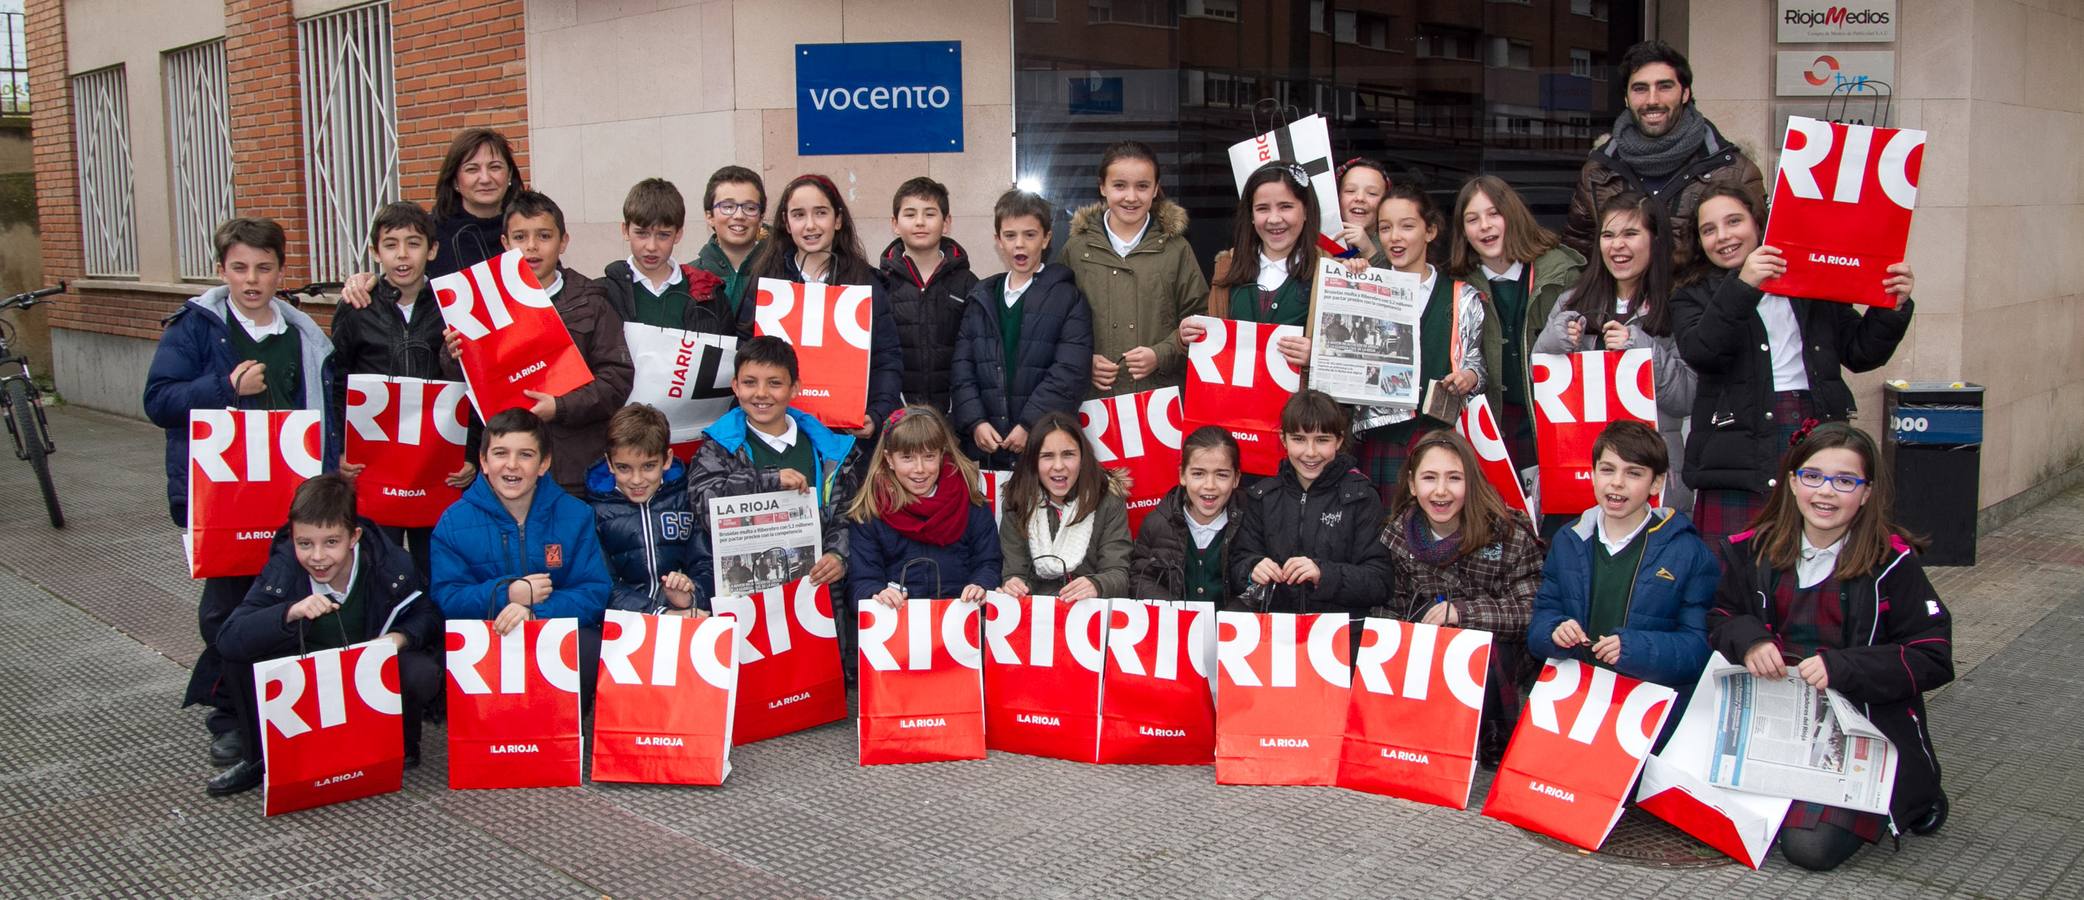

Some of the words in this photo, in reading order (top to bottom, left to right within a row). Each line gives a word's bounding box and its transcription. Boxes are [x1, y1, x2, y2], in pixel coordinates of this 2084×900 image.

[1785, 6, 1889, 28] RiojaMedios
[1835, 72, 1868, 92] tvr
[809, 85, 950, 112] vocento
[1811, 252, 1826, 264] LA
[1827, 254, 1861, 267] RIOJA
[1325, 265, 1341, 276] LA
[1344, 271, 1383, 283] RIOJA
[510, 370, 523, 383] LA
[522, 360, 547, 376] RIOJA
[802, 389, 830, 398] RIOJA
[1577, 472, 1590, 480] LA
[384, 487, 398, 497] LA
[398, 488, 427, 498] RIOJA
[717, 504, 735, 516] LA
[740, 500, 779, 514] RIOJA
[1126, 500, 1139, 510] LA
[661, 512, 694, 540] 65
[238, 531, 253, 541] LA
[252, 530, 277, 540] RIOJ
[769, 698, 784, 710] LA
[783, 691, 811, 705] RIOJA
[902, 719, 917, 729] LA
[916, 717, 946, 728] RIOJA
[1018, 713, 1033, 724] LA
[1032, 714, 1060, 727] RIOJA
[1141, 726, 1155, 737] LA
[1155, 727, 1186, 738] RIOJA
[491, 744, 508, 754] LA
[507, 744, 539, 754] RIOJA
[637, 736, 652, 746] LA
[652, 736, 684, 747] RIOJA
[1262, 738, 1277, 747] LA
[1276, 738, 1309, 748] RIOJA
[1383, 749, 1398, 760] LA
[1397, 750, 1429, 765] RIOJA
[316, 776, 331, 788] LA
[332, 770, 365, 785] RIOJA
[1531, 780, 1545, 794] LA
[1544, 785, 1575, 803] RIOJA
